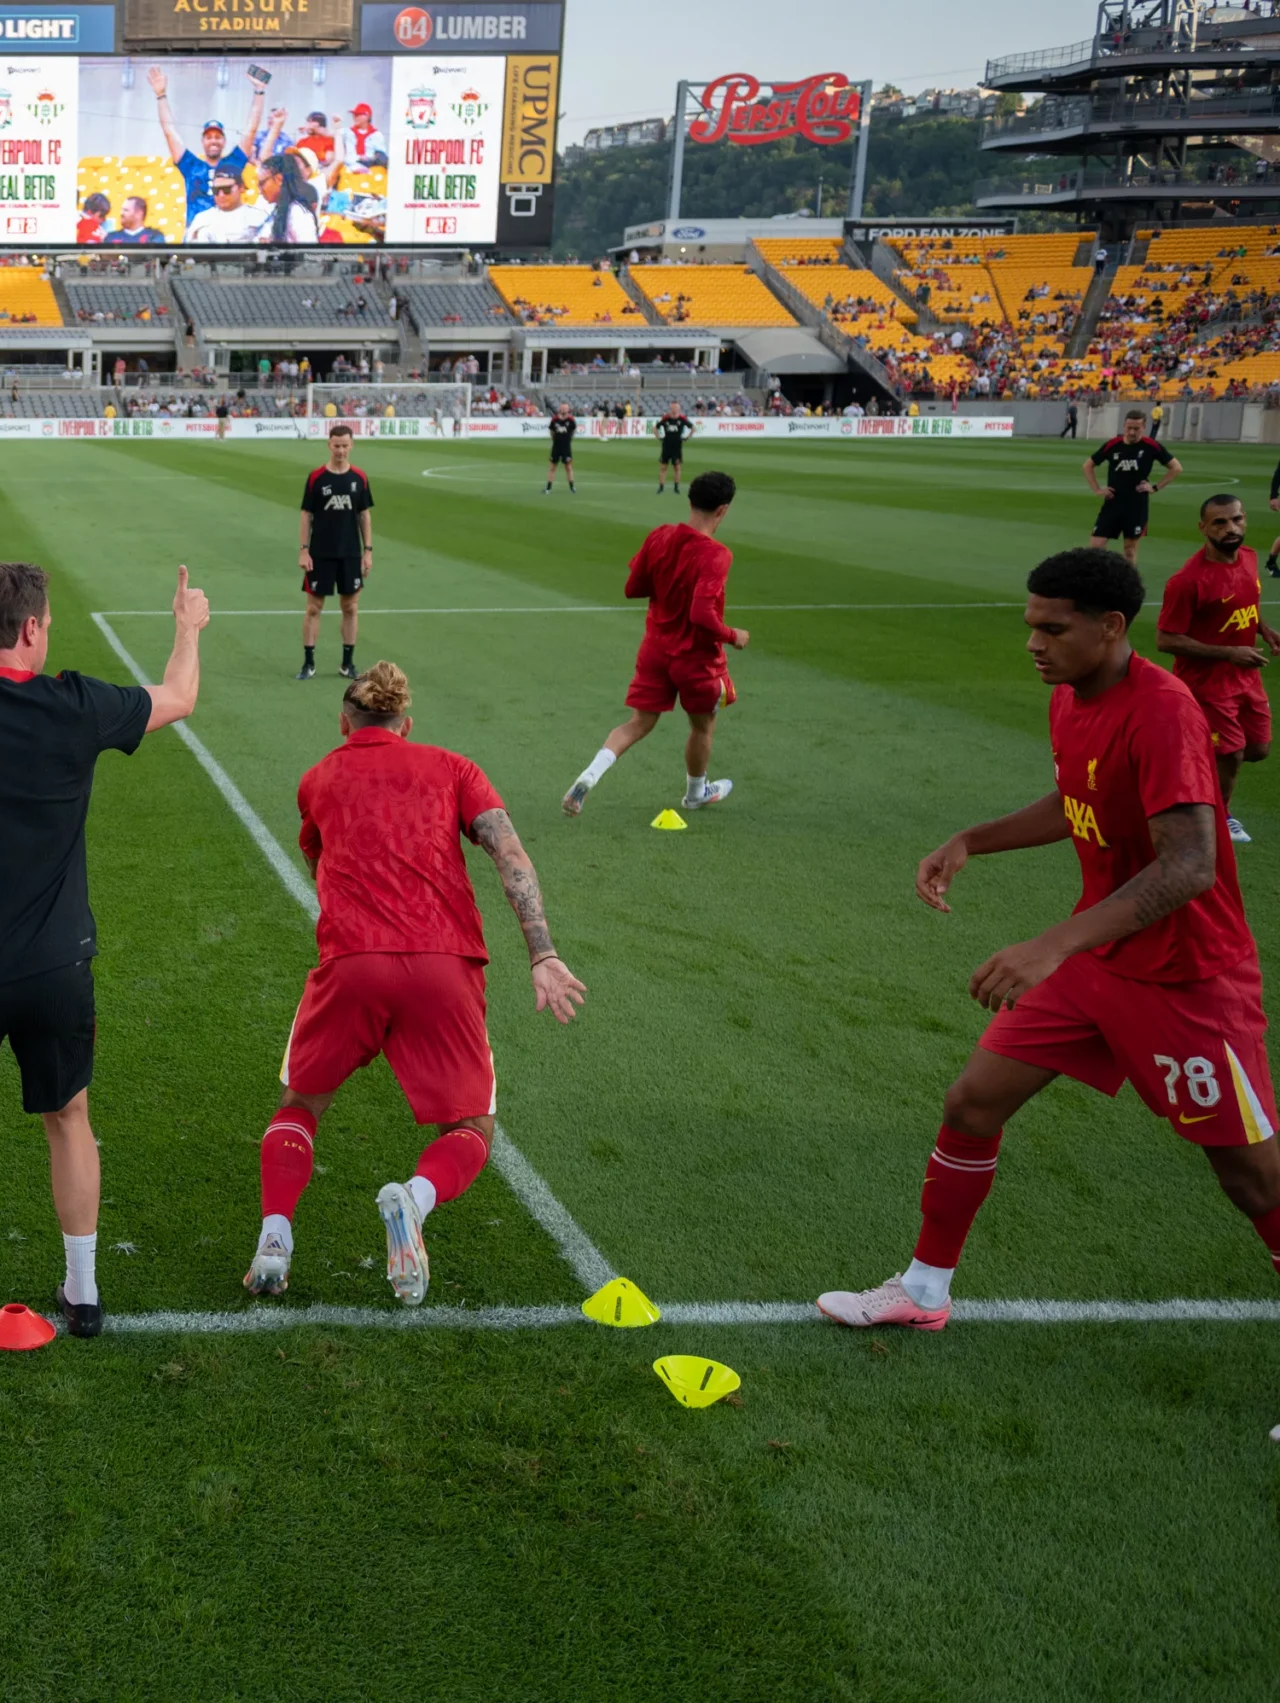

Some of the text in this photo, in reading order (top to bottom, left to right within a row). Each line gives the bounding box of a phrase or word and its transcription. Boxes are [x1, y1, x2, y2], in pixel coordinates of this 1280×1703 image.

[173, 0, 309, 13] ACRISURE
[5, 19, 75, 39] LIGHT
[199, 17, 280, 31] STADIUM
[398, 16, 527, 40] 84 LUMBER
[518, 62, 552, 176] UPMC
[48, 139, 62, 165] FC
[405, 139, 484, 165] LIVERPOOL FC
[23, 175, 56, 201] BETIS
[413, 174, 477, 200] REAL BETIS
[868, 228, 1005, 241] FORD FAN ZONE
[58, 420, 153, 436] LIVERPOOL FC REAL BETIS
[379, 419, 398, 435] REAL
[399, 419, 420, 435] BETIS
[631, 419, 640, 435] FC
[718, 422, 765, 431] PITTSBURGH
[856, 419, 953, 435] LIVERPOOL FC REAL BETIS
[1115, 459, 1139, 471] AXA
[324, 495, 353, 510] AXA
[1218, 604, 1259, 633] AXA
[1064, 795, 1110, 848] AXA
[1153, 1053, 1222, 1108] 78
